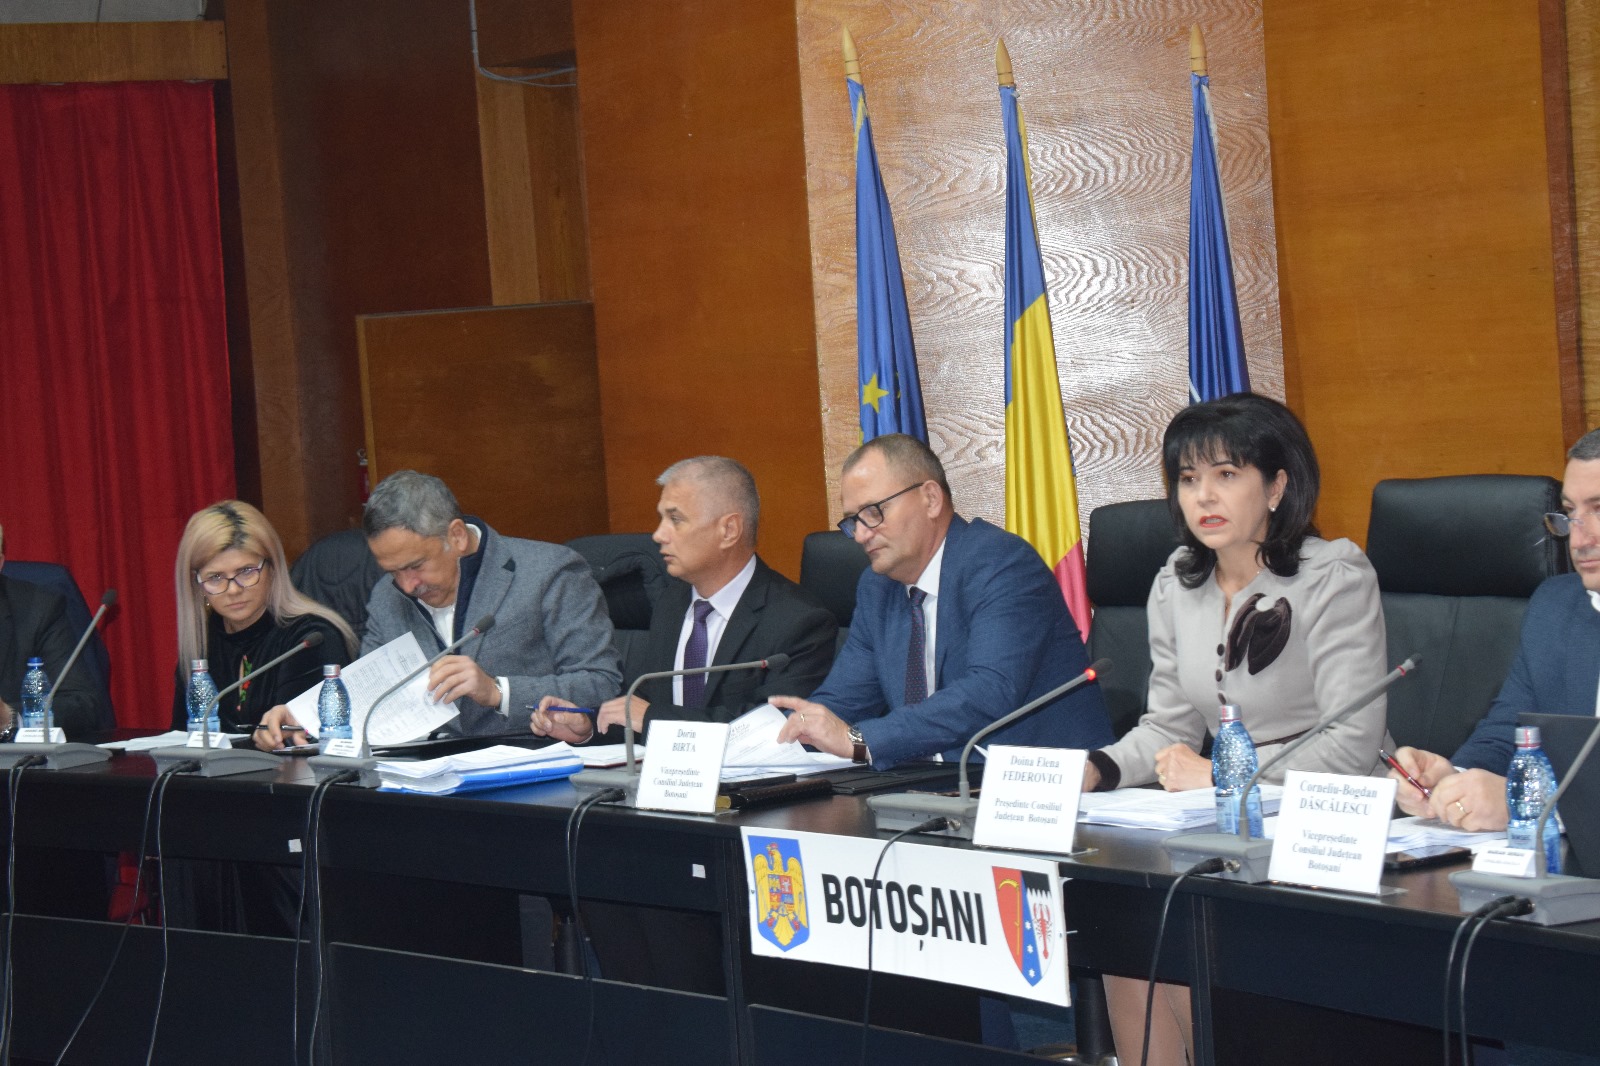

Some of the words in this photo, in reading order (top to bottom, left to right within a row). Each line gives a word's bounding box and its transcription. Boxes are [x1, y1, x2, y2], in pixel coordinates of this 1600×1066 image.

[677, 729, 696, 738] Dorin
[672, 742, 696, 752] BIRTA
[1010, 755, 1034, 767] Doina
[1036, 757, 1060, 768] Elena
[1002, 770, 1063, 784] FEDEROVICI
[1300, 780, 1378, 798] Corneliu-Bogdan
[1299, 796, 1370, 815] DĂSCĂLESCU
[821, 873, 988, 952] BOTOȘANI
